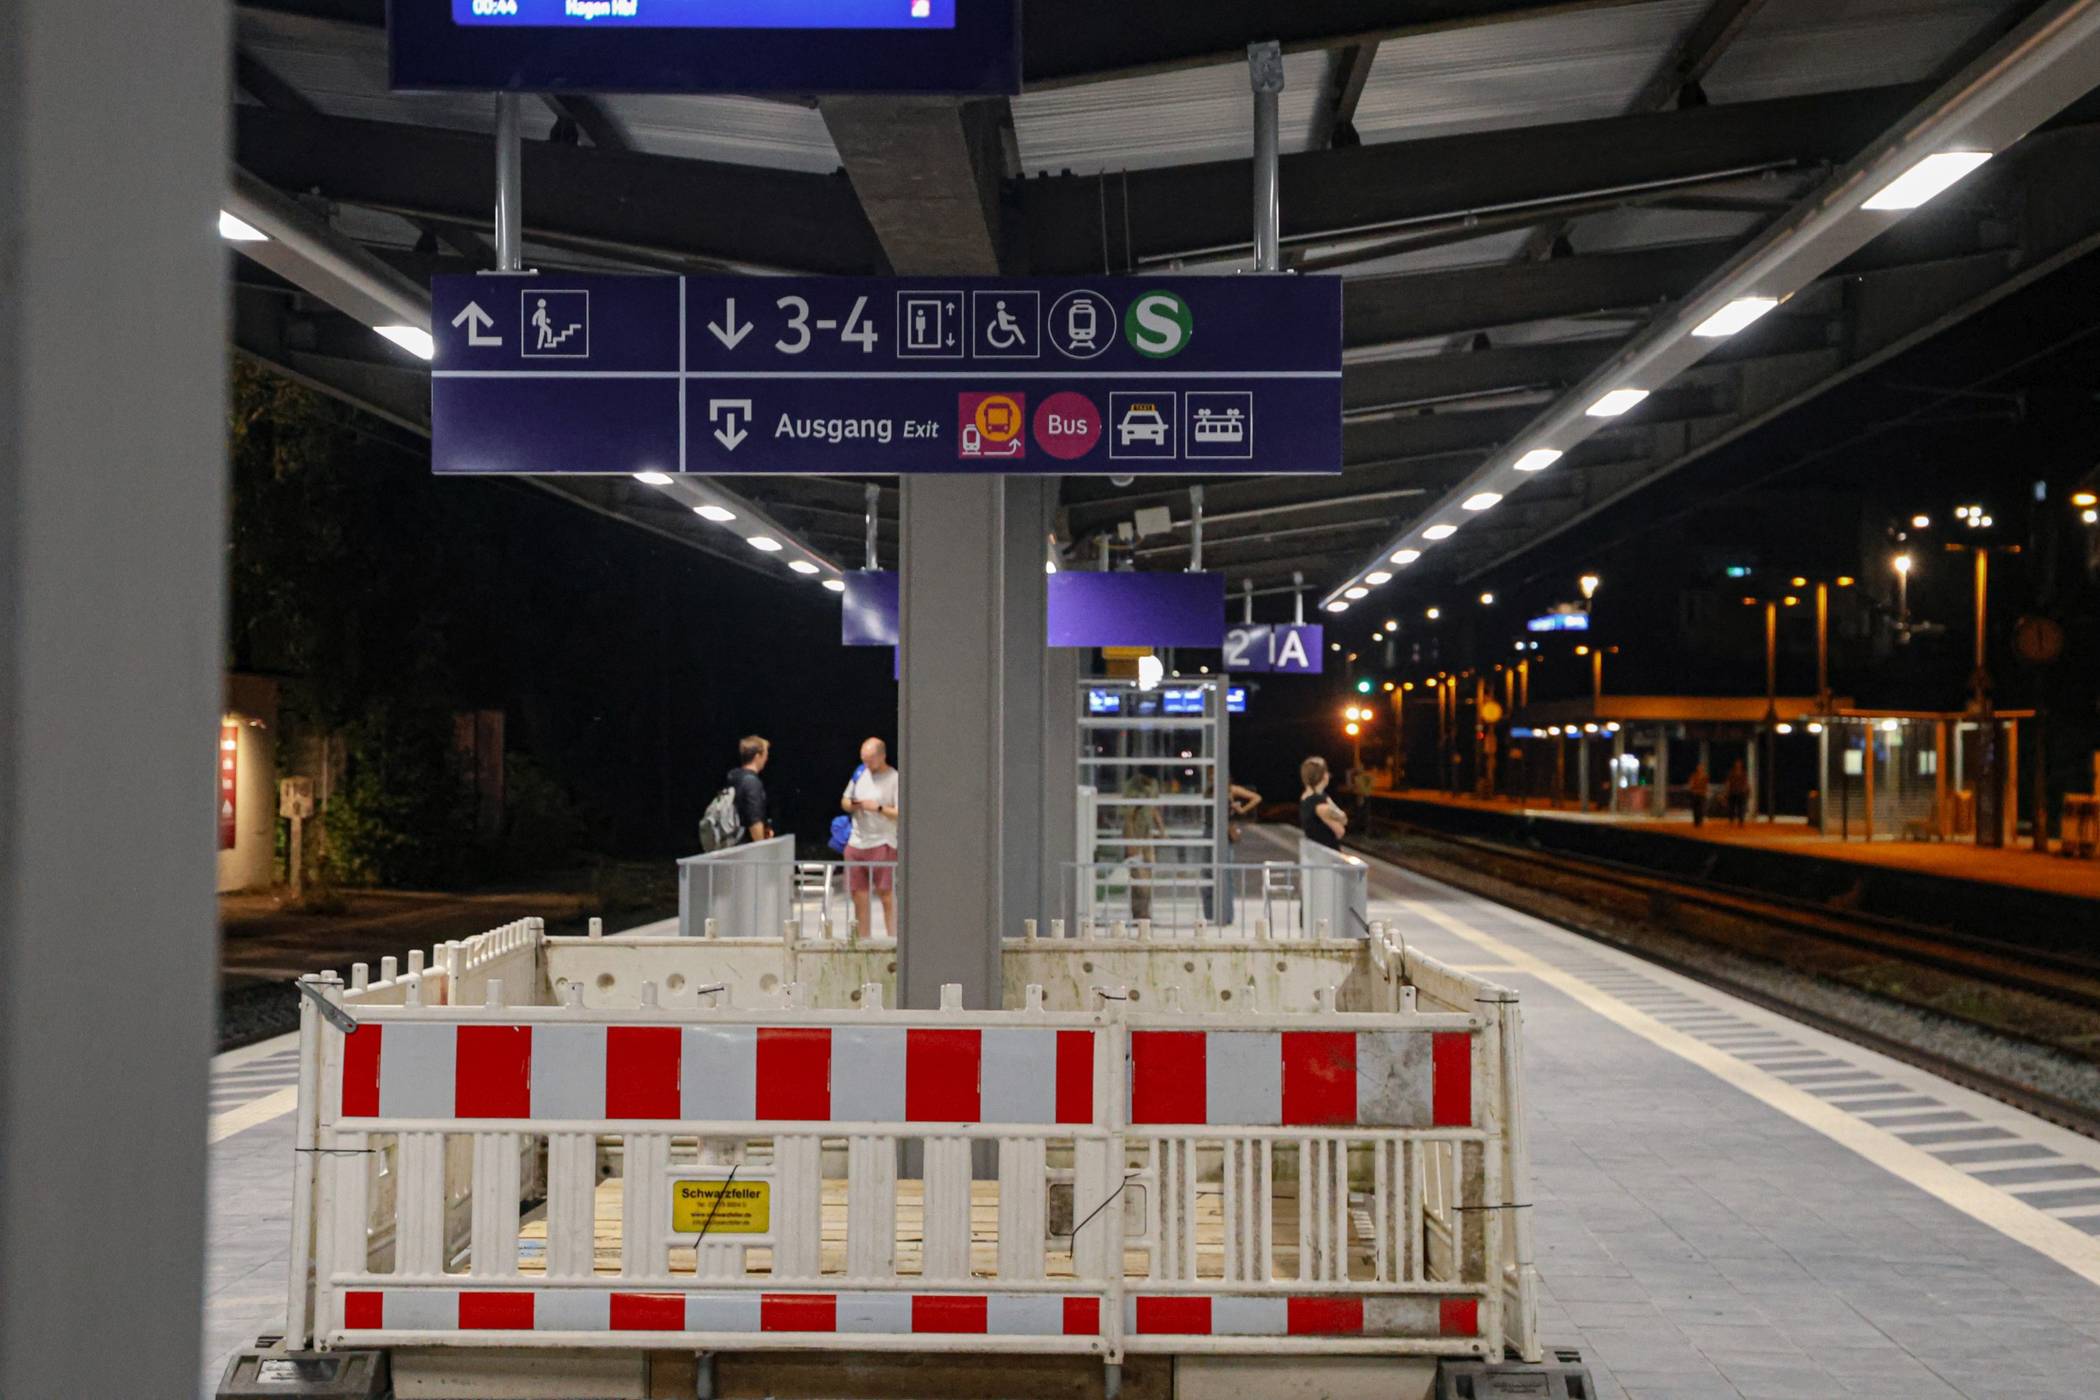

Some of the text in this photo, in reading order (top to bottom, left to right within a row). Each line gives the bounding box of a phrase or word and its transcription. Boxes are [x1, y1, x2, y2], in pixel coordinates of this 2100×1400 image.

[565, 0, 610, 20] Hagen
[775, 295, 1182, 354] 3-4 S
[775, 413, 1088, 443] Ausgang Exit Bus
[1227, 628, 1309, 668] 2 A
